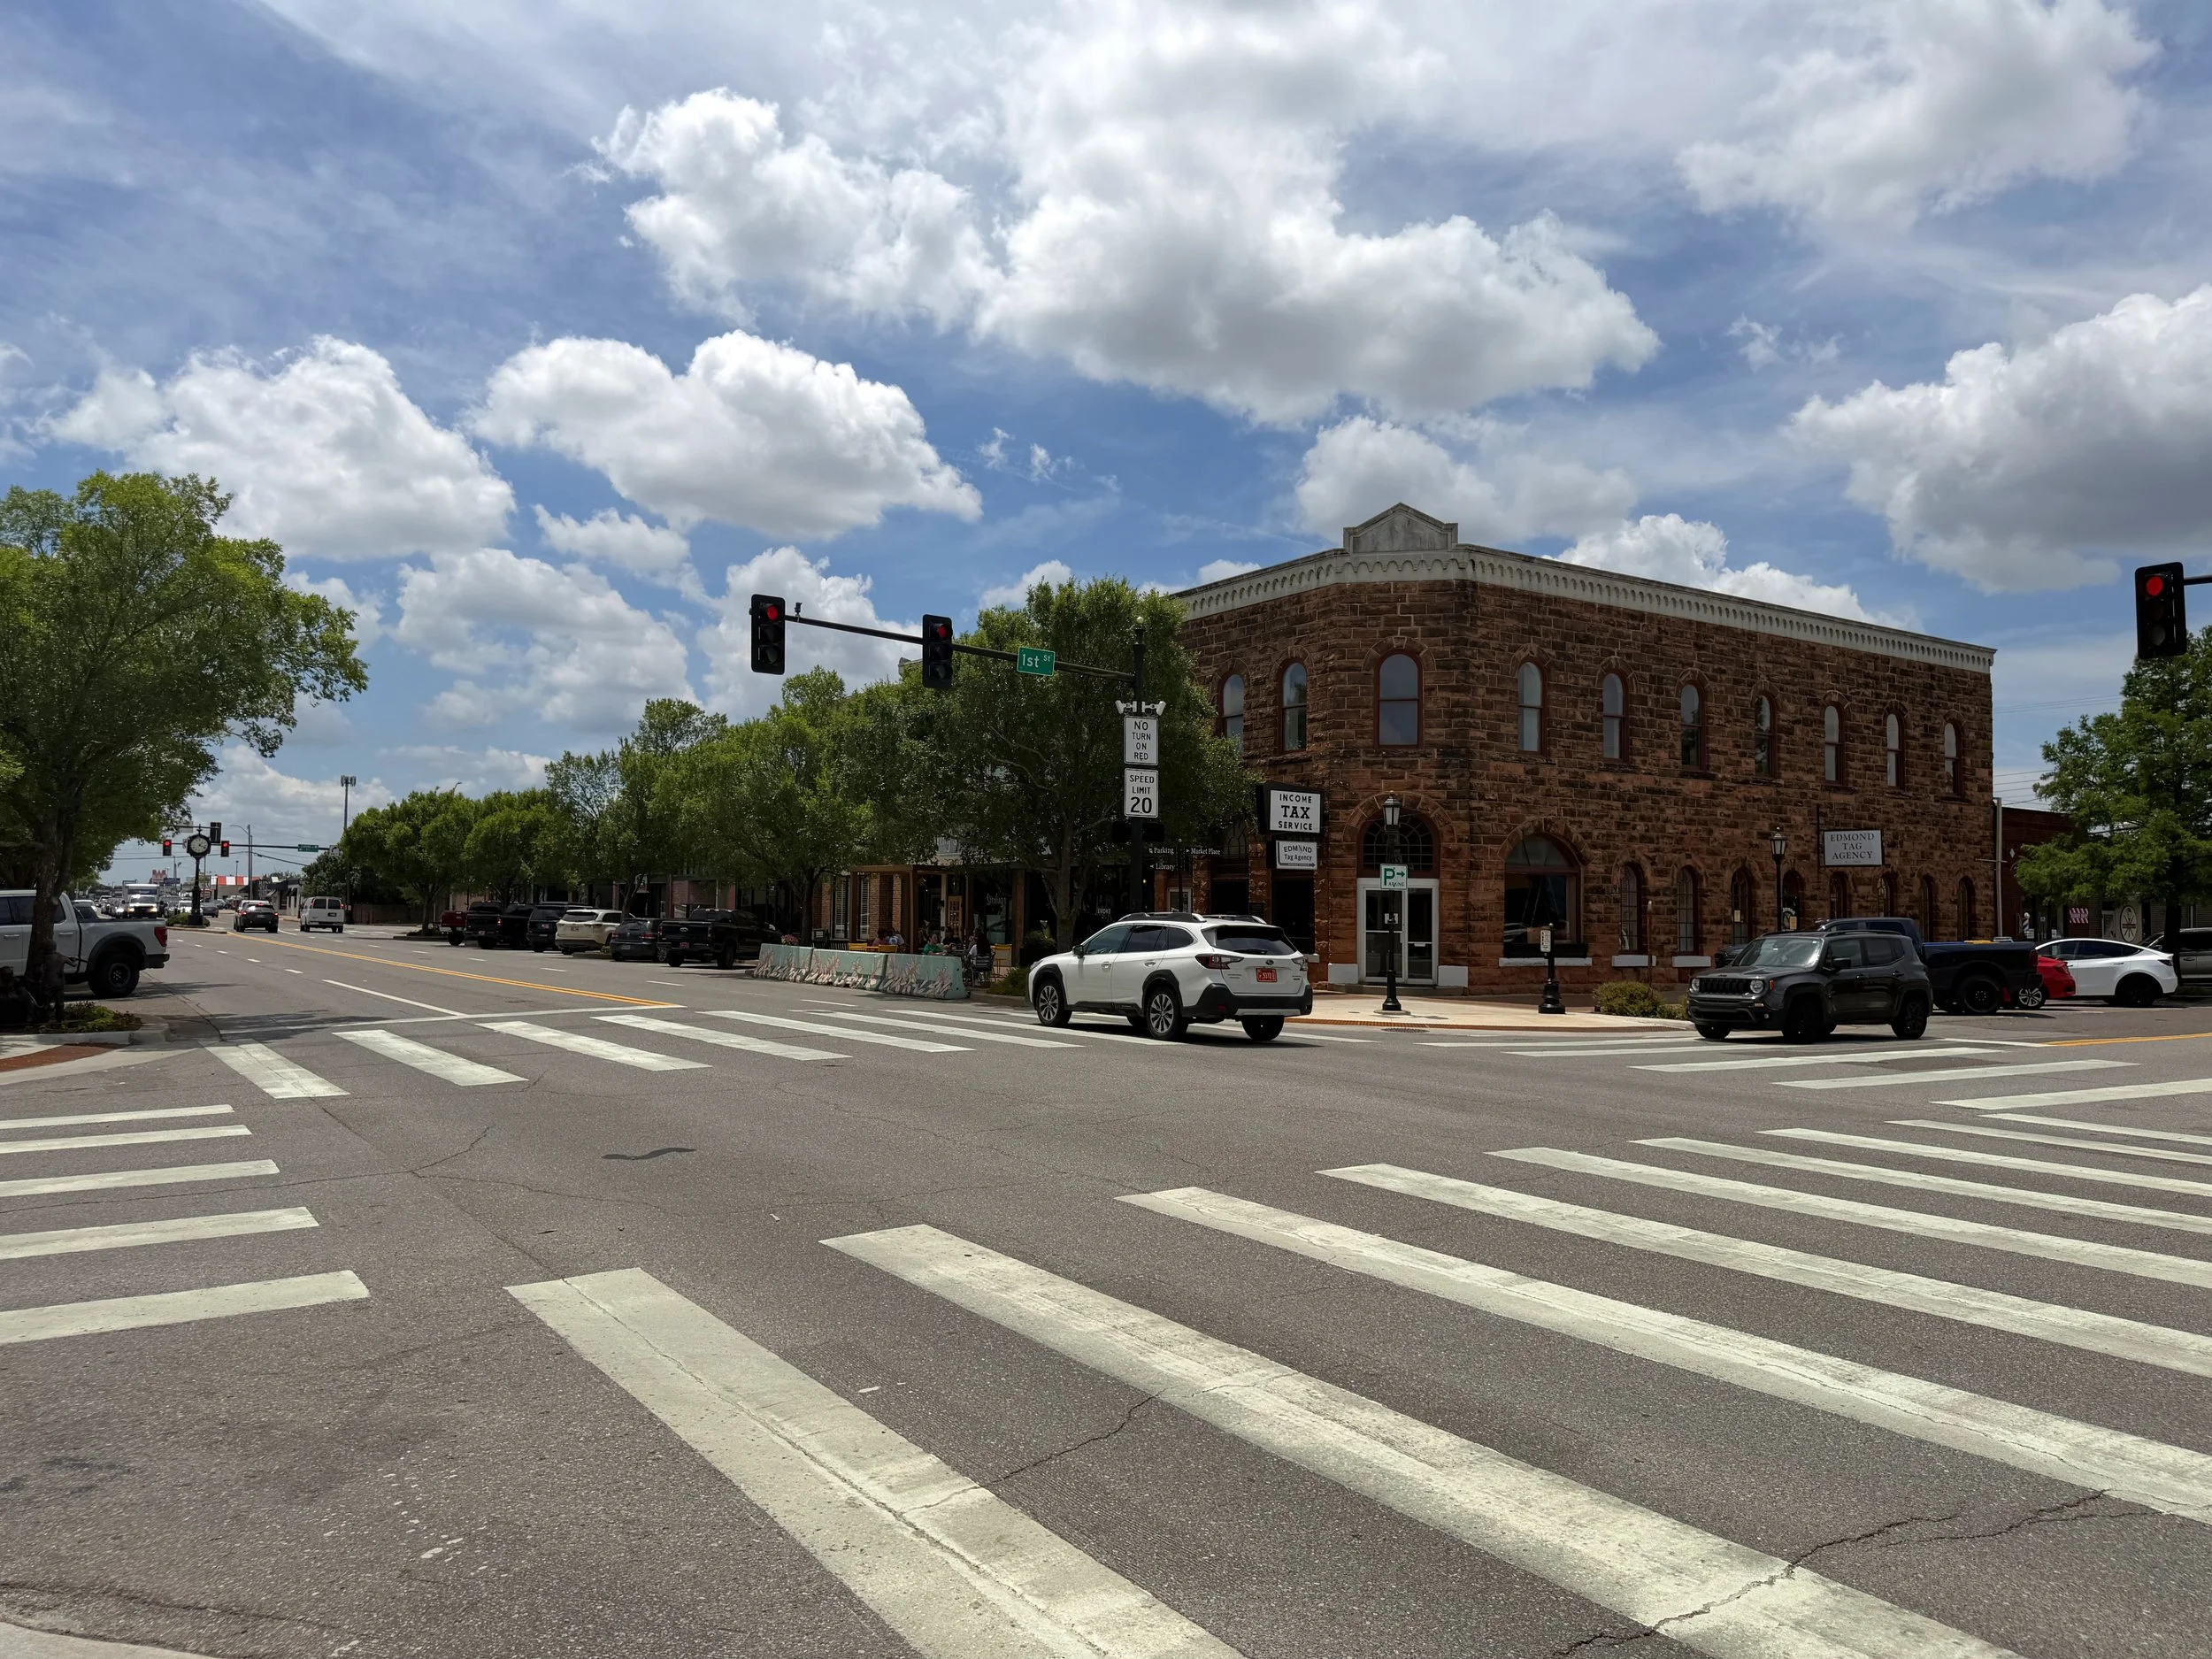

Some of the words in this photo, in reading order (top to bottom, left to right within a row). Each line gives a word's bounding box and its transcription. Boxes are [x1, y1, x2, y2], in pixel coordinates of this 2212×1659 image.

[1022, 653, 1039, 668] 1st
[1134, 721, 1148, 731] NO
[1133, 732, 1151, 741] TURN
[1129, 774, 1155, 784] SPEED
[1132, 786, 1151, 795] LIMIT
[1279, 793, 1312, 803] INCOME
[1130, 796, 1152, 814] 20
[1281, 805, 1310, 818] TAX
[1278, 820, 1313, 831] SERVICE
[1831, 833, 1874, 841] EDMOND
